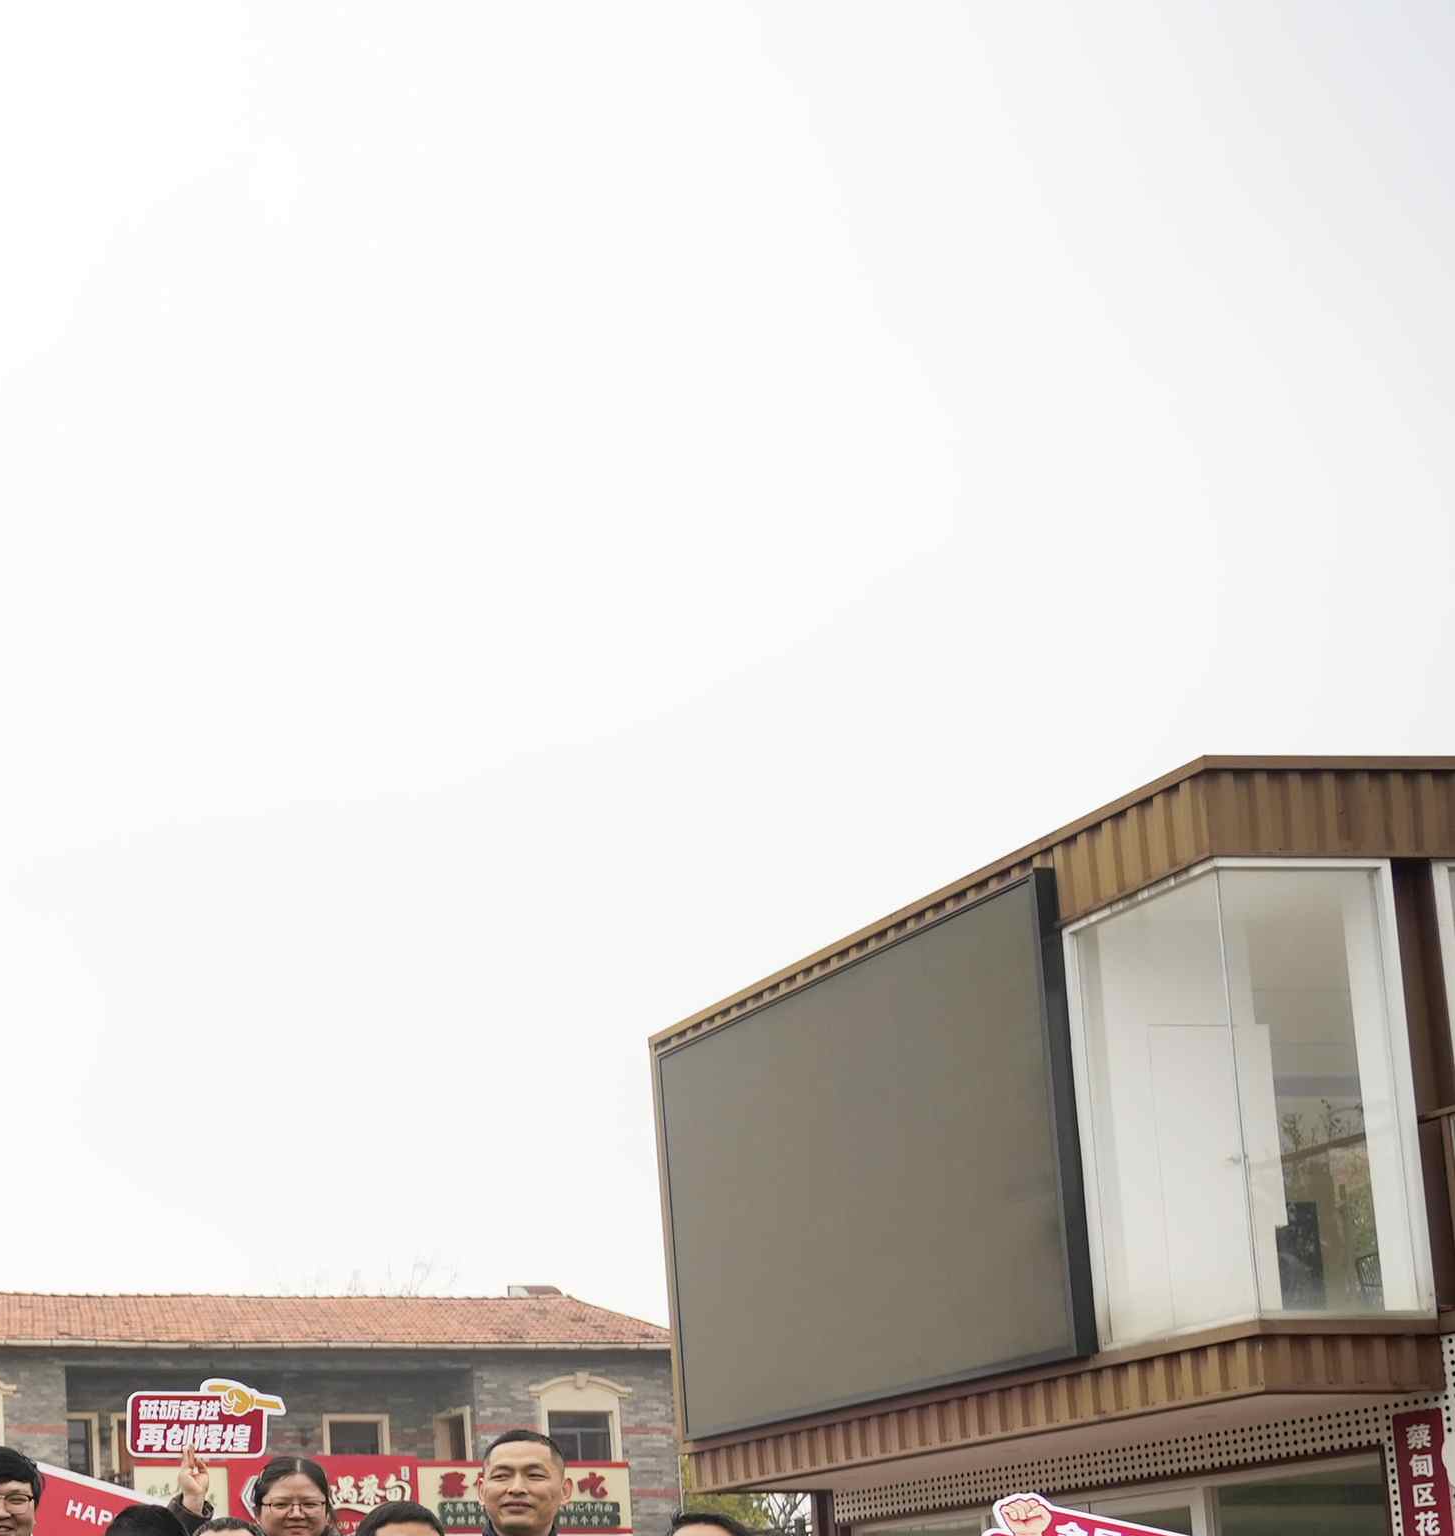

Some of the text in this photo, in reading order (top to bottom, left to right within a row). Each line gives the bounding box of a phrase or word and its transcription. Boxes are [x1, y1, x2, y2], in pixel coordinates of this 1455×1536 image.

[137, 1423, 251, 1452] 再创辉煌
[65, 1499, 117, 1526] HAP
